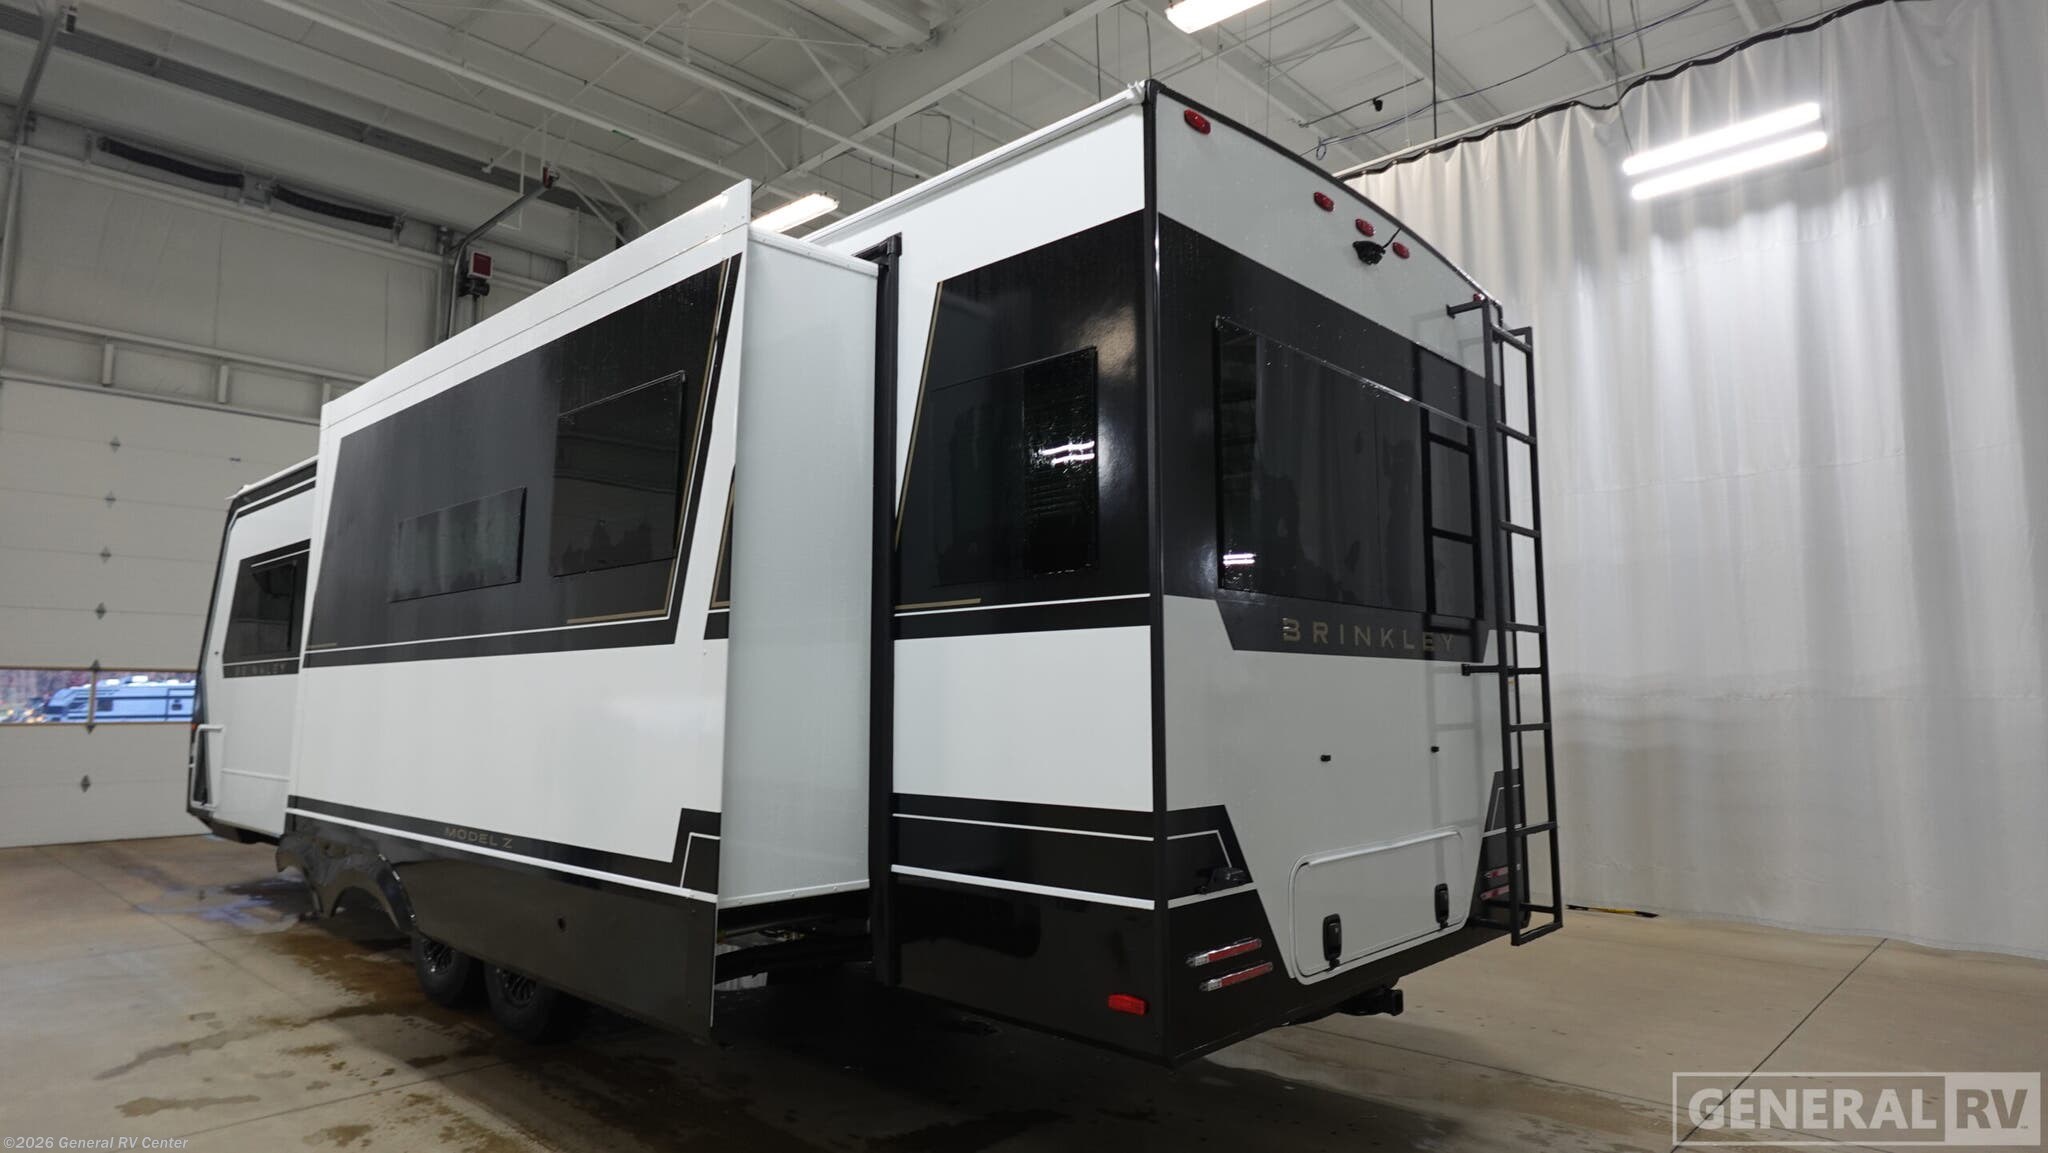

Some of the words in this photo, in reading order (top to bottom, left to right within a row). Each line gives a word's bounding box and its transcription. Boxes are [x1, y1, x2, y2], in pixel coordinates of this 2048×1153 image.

[1282, 617, 1456, 652] BRINKLEY
[446, 826, 498, 847] MODEL
[502, 837, 513, 849] Z
